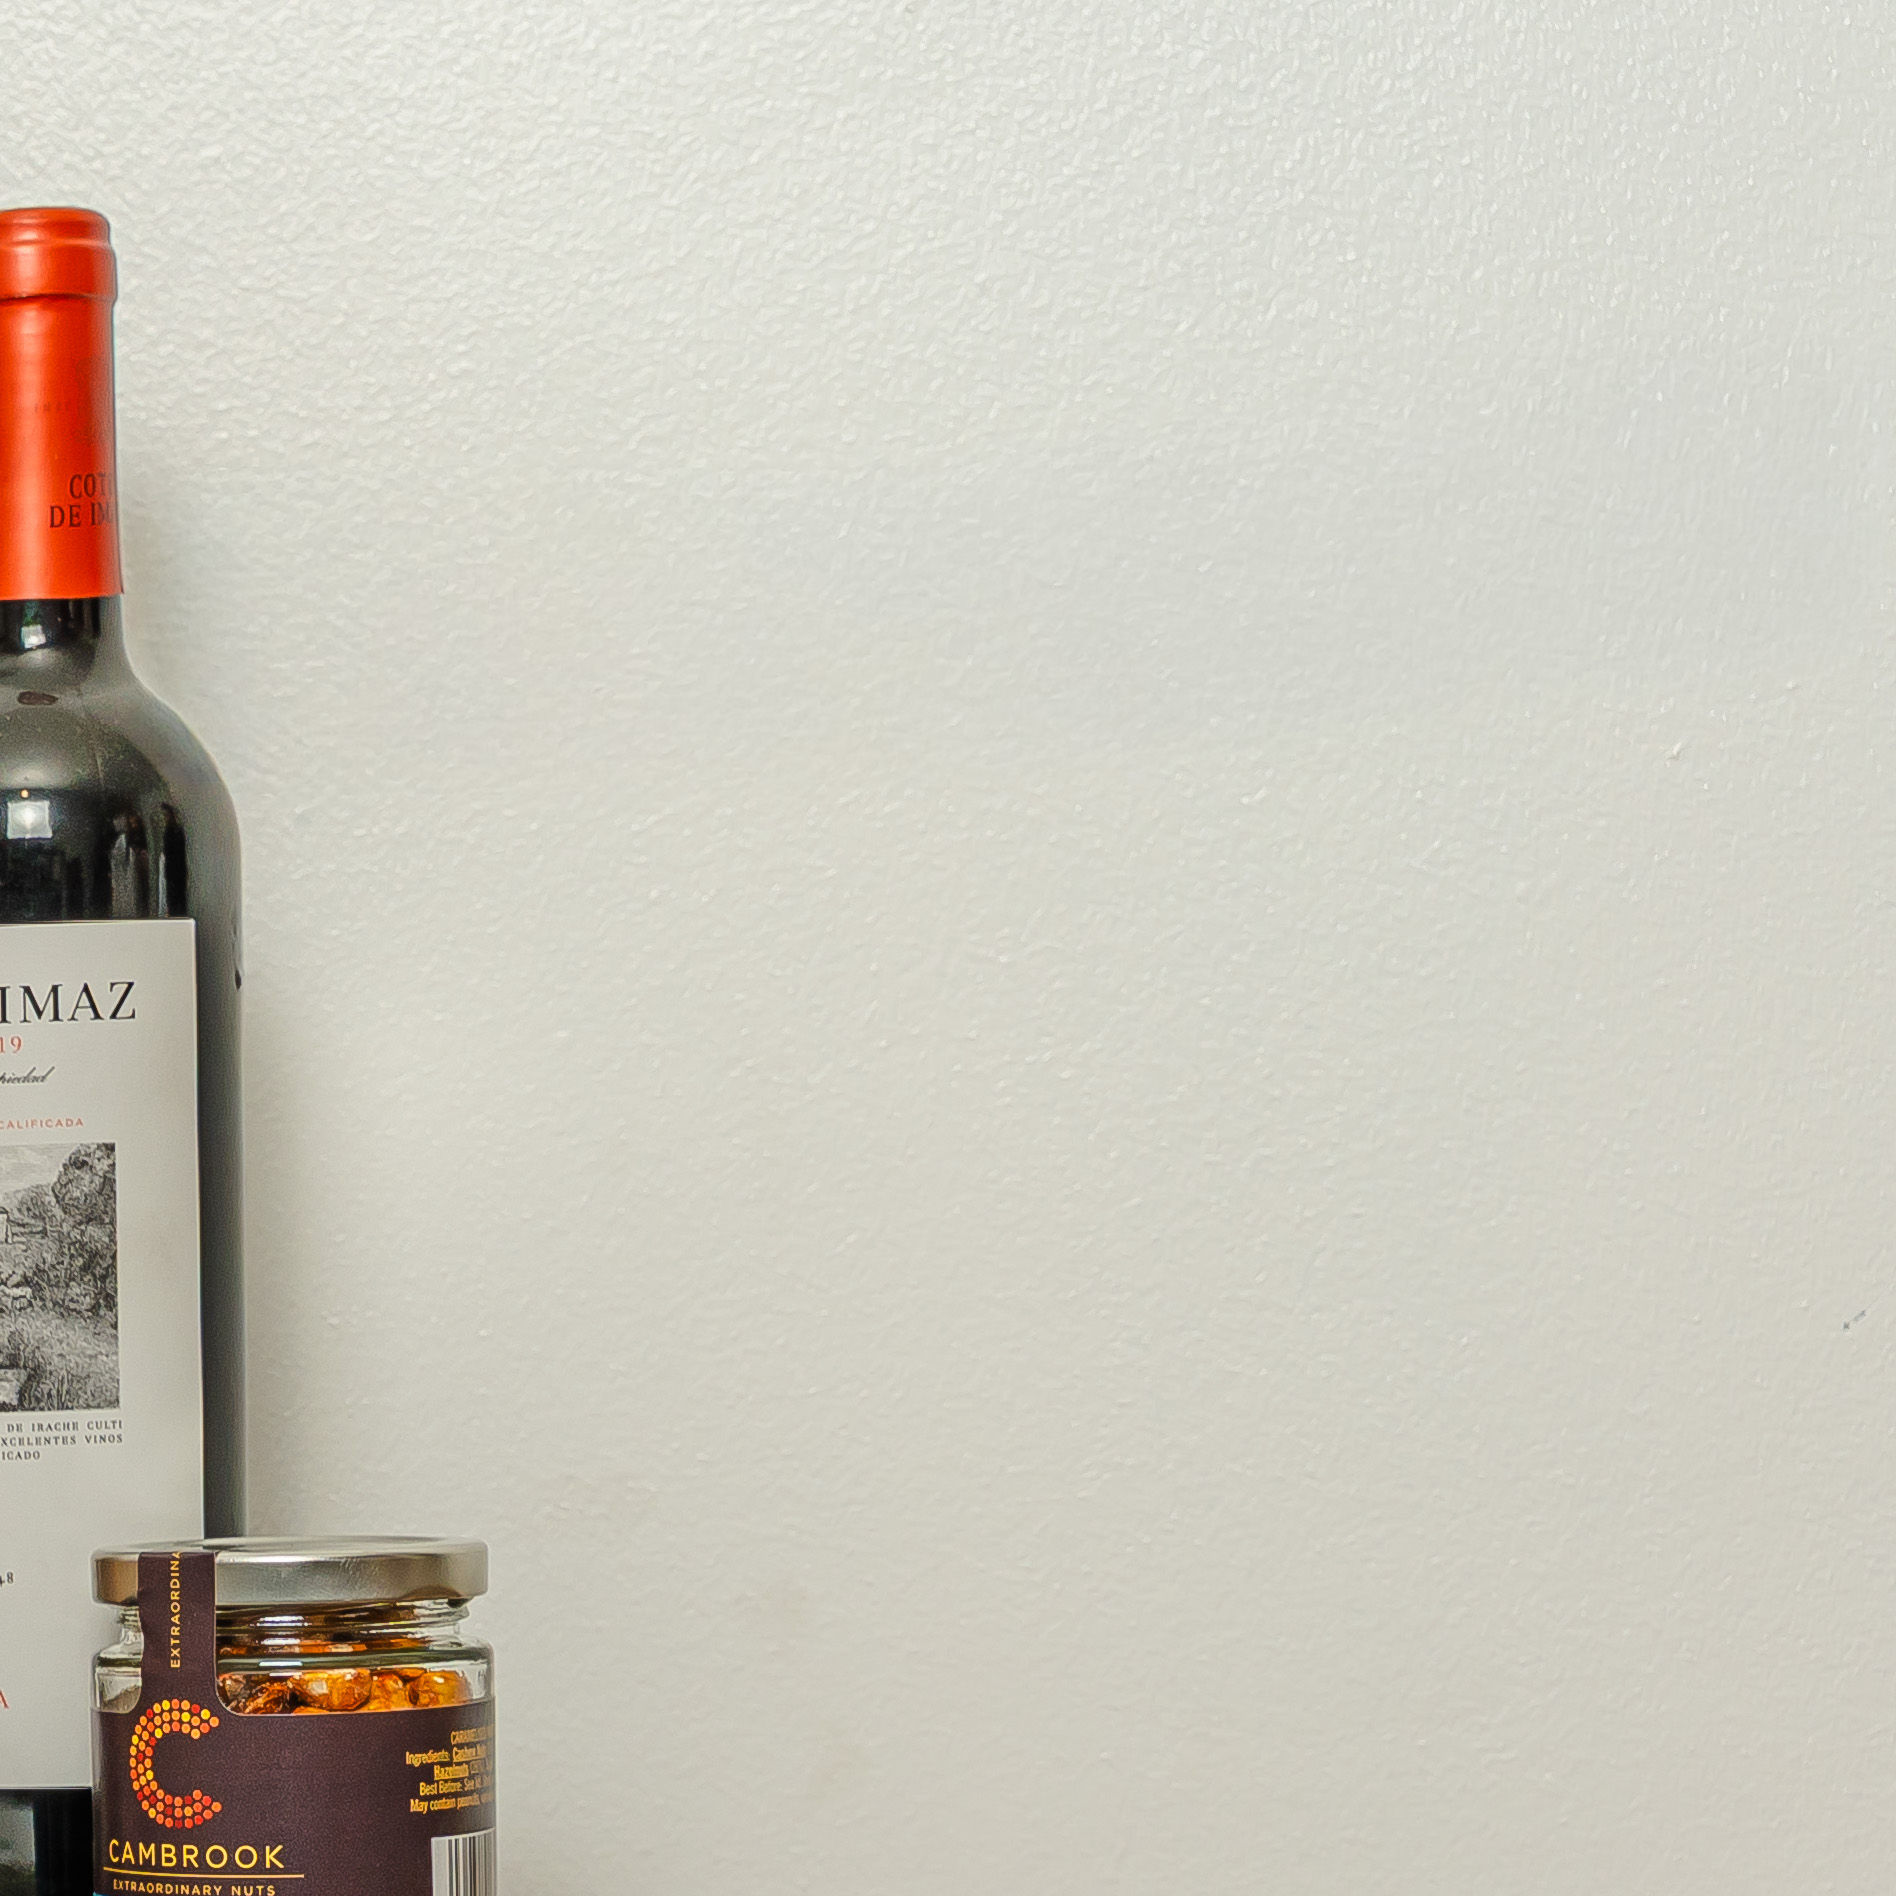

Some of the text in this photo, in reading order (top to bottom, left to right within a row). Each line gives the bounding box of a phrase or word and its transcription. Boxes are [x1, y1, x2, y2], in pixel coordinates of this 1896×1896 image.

[109, 1839, 284, 1869] CAMBROOK
[113, 1880, 276, 1896] EXTRAORDINARY NUTS
